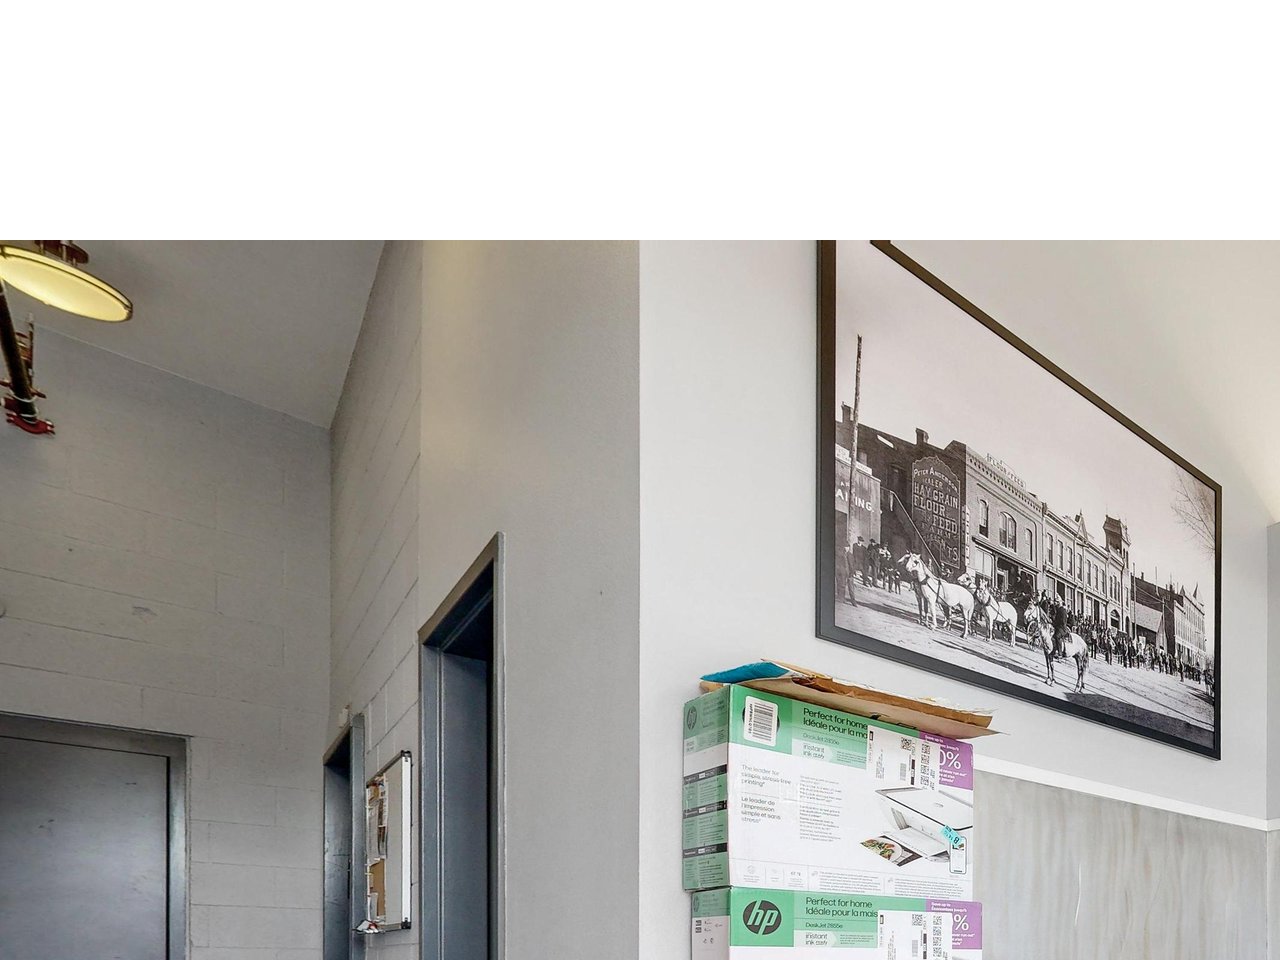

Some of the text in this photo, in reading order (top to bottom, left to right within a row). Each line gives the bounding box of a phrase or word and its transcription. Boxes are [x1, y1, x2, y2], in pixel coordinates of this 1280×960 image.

[914, 480, 931, 498] HAY
[932, 489, 958, 509] GRAIN
[913, 494, 946, 516] FLOUR
[932, 514, 958, 535] FEED
[803, 707, 833, 722] Perfect
[834, 715, 847, 725] for
[803, 717, 828, 730] Idéale
[828, 725, 847, 734] pour
[847, 728, 855, 736] la
[805, 896, 873, 908] Perfect for home
[805, 906, 831, 916] Idéale
[832, 908, 851, 917] pour
[851, 909, 859, 917] la
[747, 900, 779, 935] hp
